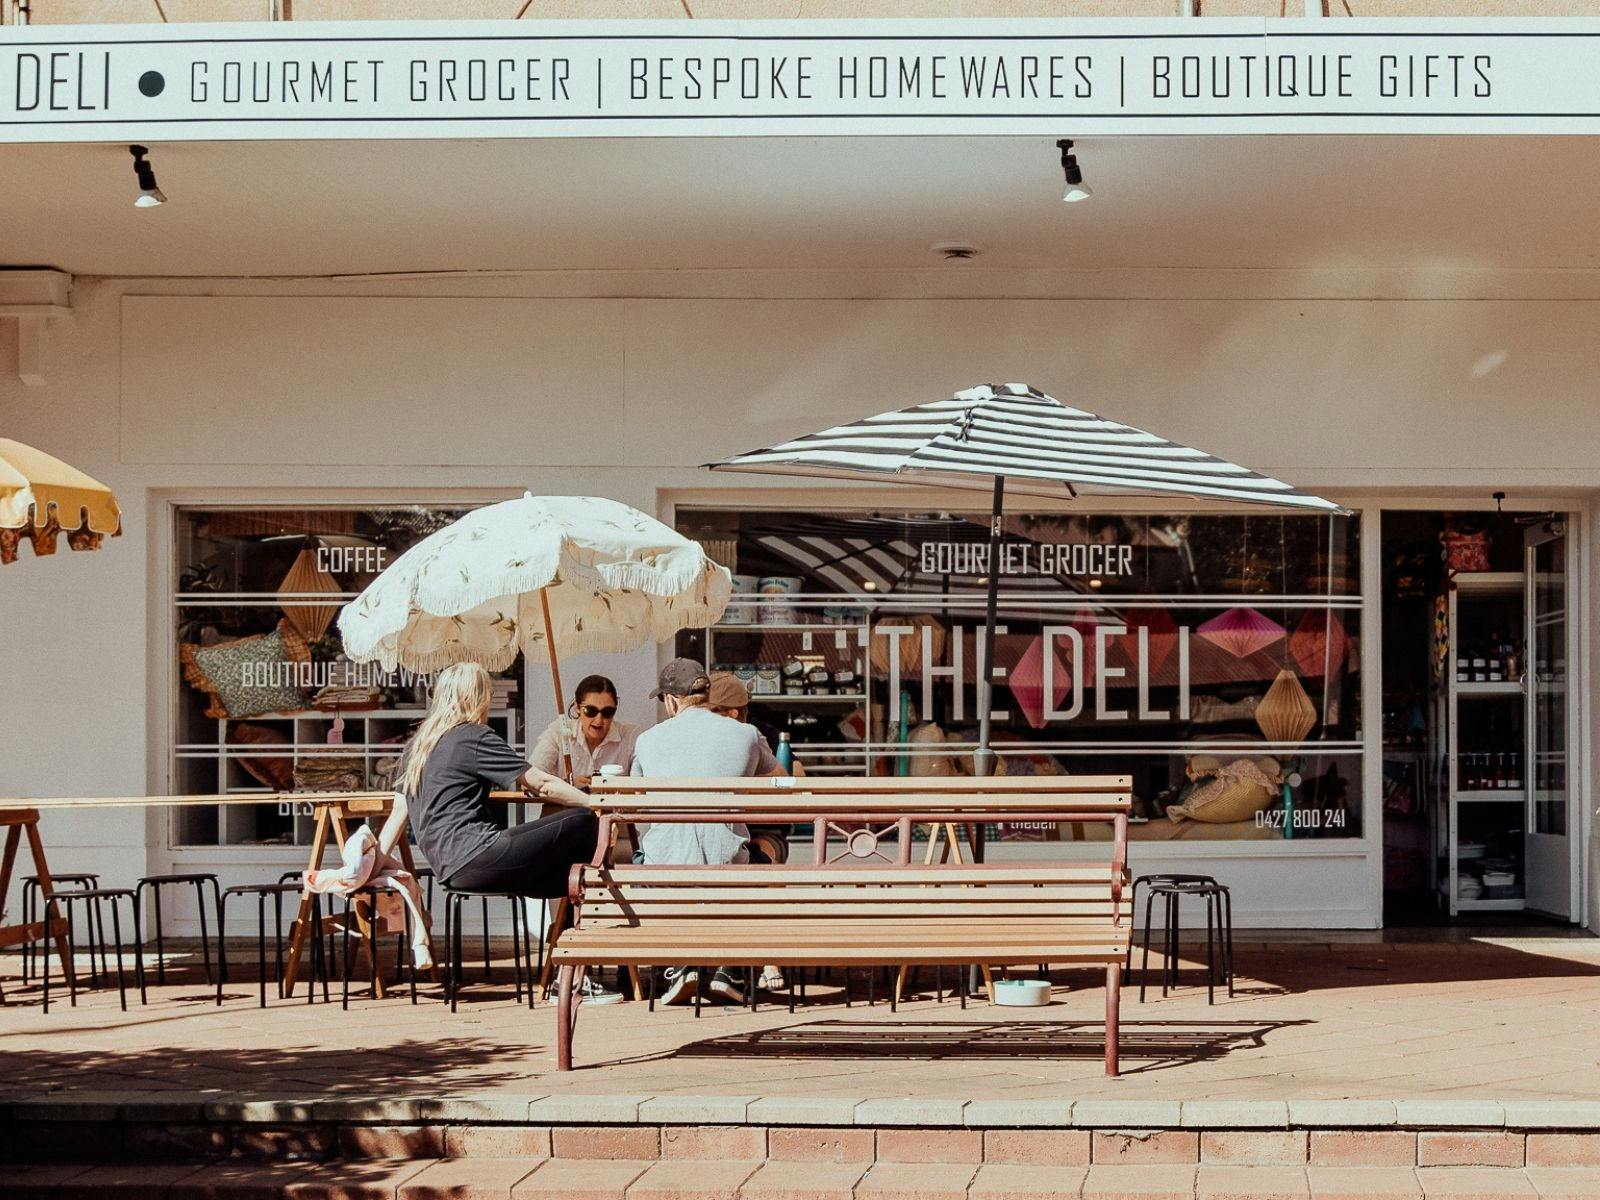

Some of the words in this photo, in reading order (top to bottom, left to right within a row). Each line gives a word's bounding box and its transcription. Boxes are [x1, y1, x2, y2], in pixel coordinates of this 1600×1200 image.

[16, 52, 110, 111] DELI
[190, 60, 384, 103] GOURMET
[410, 58, 570, 102] GROCER
[630, 56, 812, 100] BESPOKE
[839, 56, 1092, 99] HOMEWARES
[1153, 54, 1353, 98] BOUTIQUE
[1379, 55, 1492, 98] GIFTS
[316, 546, 387, 573] COFFEE
[1039, 544, 1133, 576] GROCER
[242, 661, 338, 688] BOUTIQUE
[875, 625, 1010, 721] THE
[1042, 625, 1190, 721] DELI
[1255, 809, 1289, 829] 0427
[1293, 809, 1320, 828] 800
[1324, 808, 1346, 828] 241
